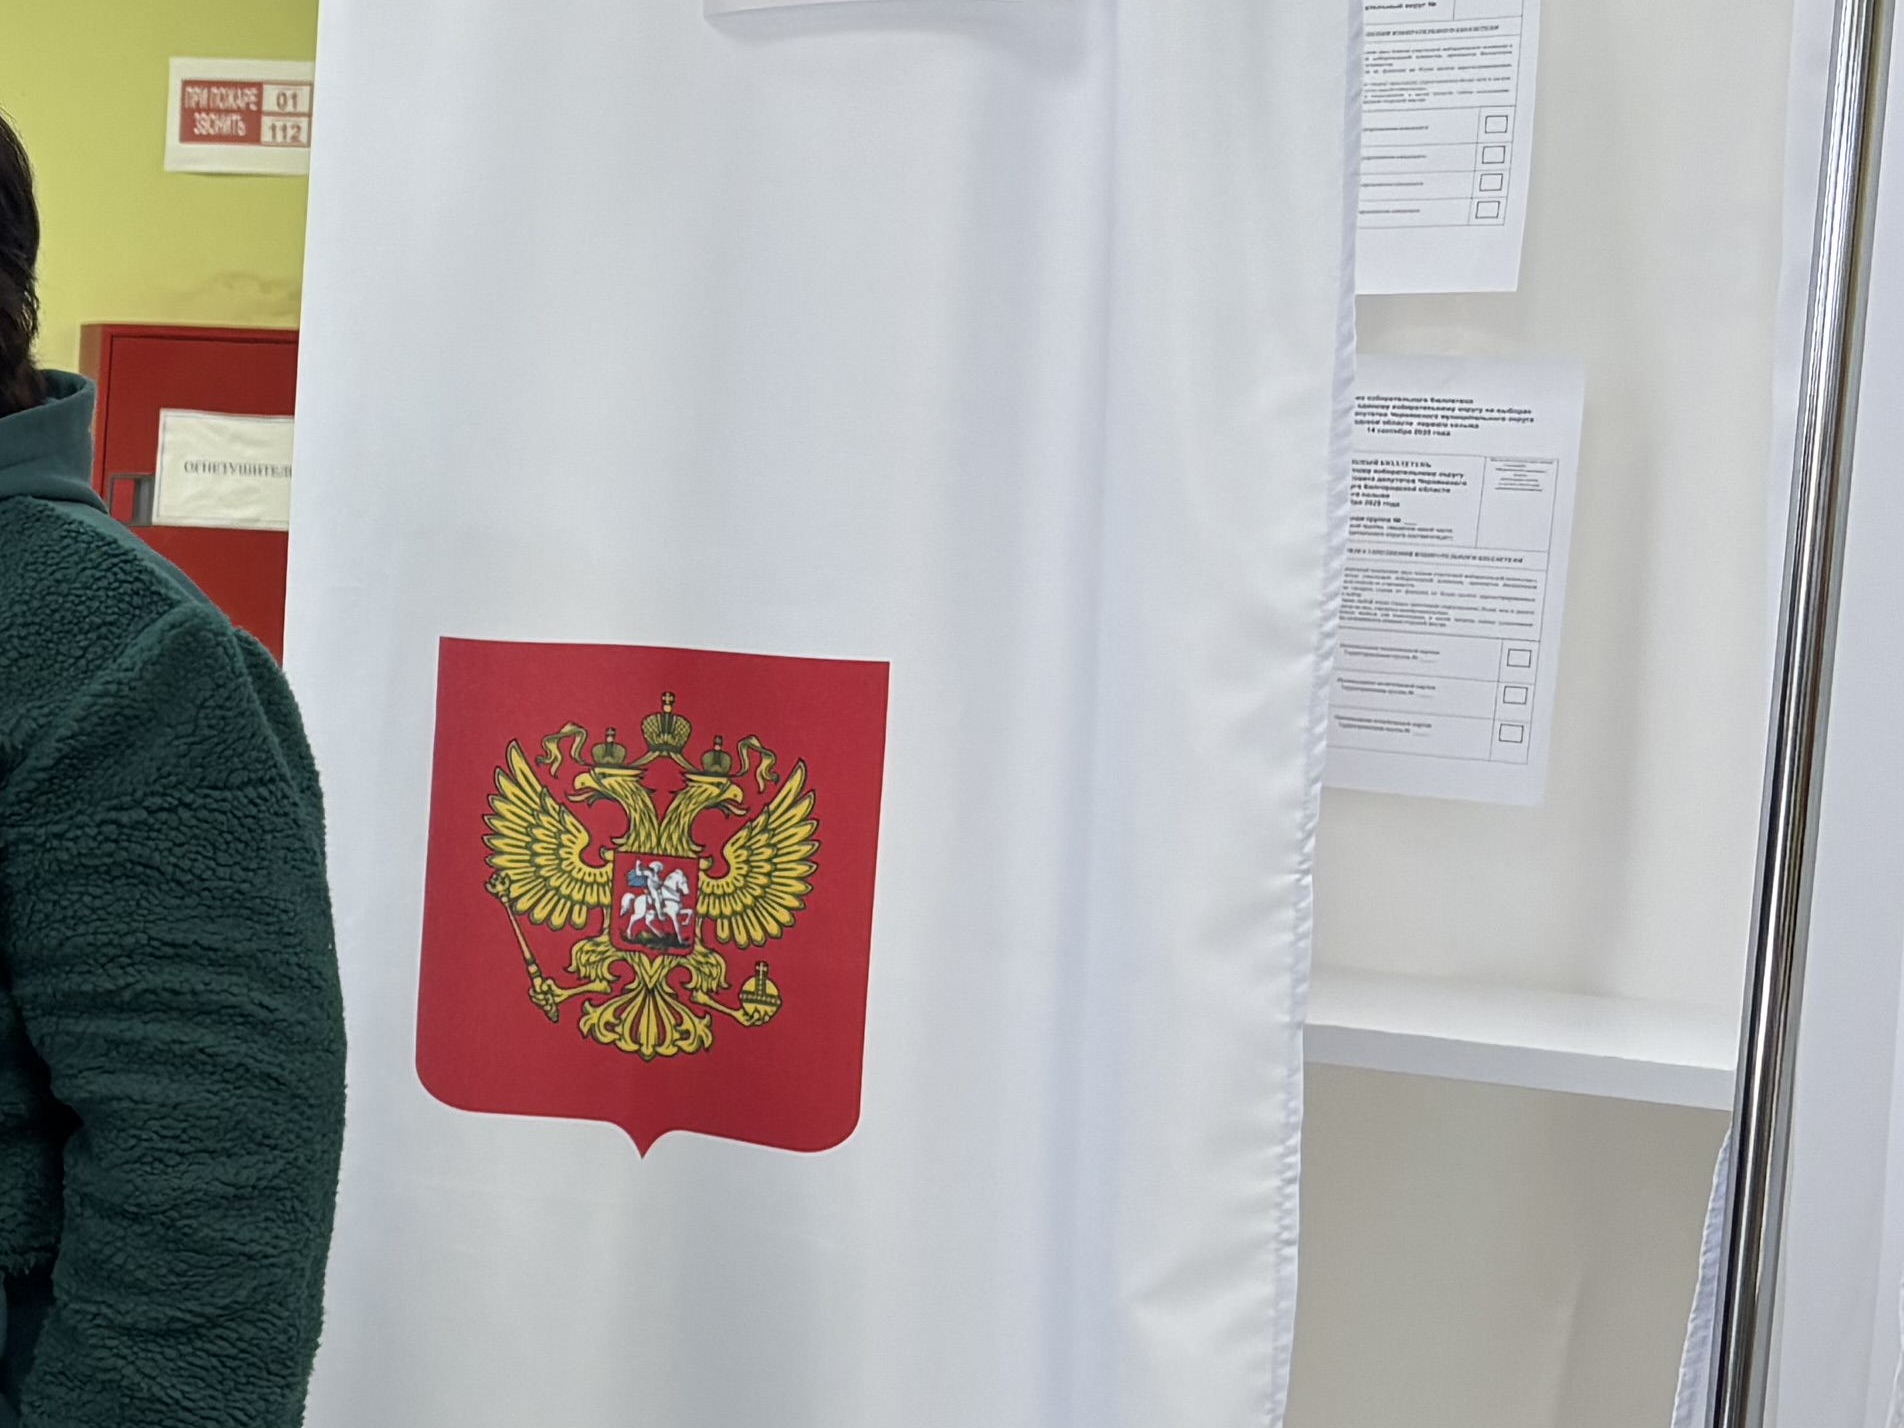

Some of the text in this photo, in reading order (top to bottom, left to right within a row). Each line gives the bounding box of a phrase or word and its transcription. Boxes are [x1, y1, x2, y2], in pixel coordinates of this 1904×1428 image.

[185, 86, 258, 110] ПРИ ПОЖАРЕ
[275, 91, 298, 111] 01
[193, 112, 247, 136] ЗВОНИТЬ
[269, 123, 303, 144] 112
[184, 460, 292, 479] ОГНЕТУШИТЕЛ
